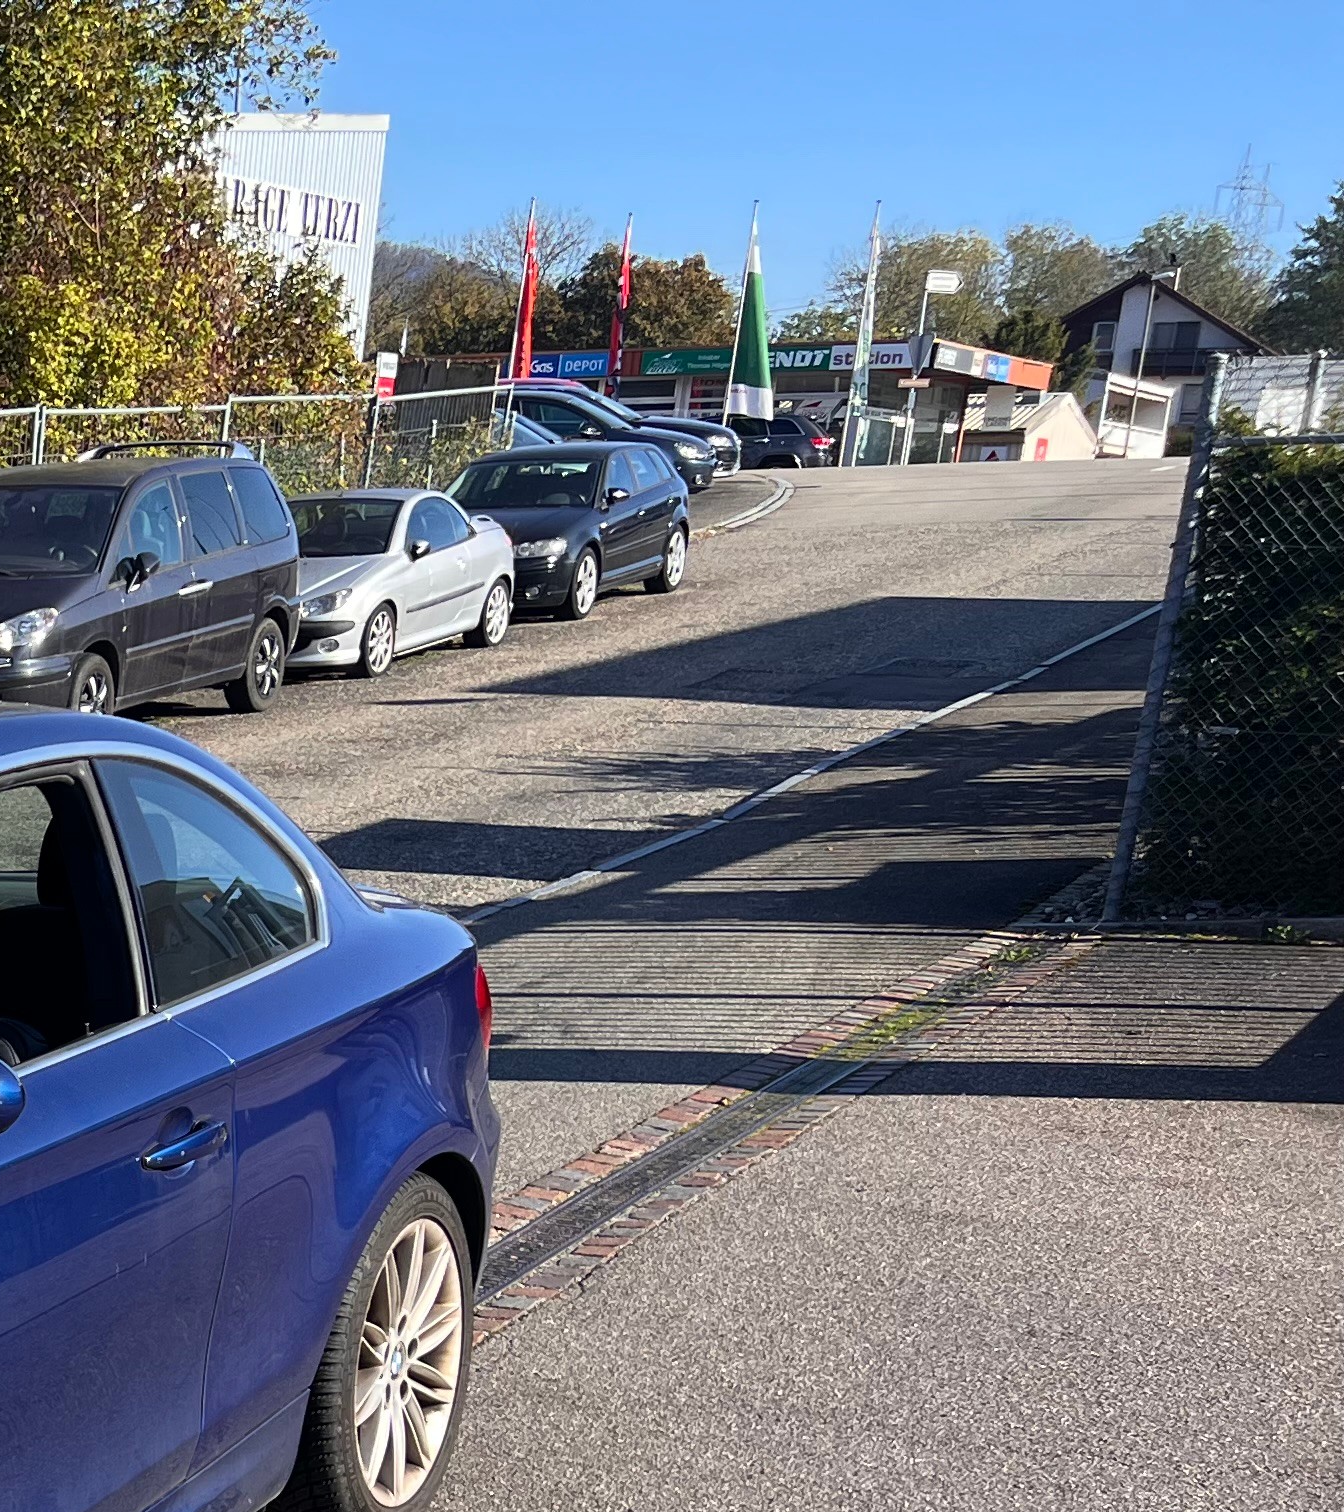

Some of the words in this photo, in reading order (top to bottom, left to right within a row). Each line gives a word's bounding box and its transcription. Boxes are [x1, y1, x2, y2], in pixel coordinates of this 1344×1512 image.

[223, 177, 291, 233] RAGE
[299, 191, 361, 245] TERZI
[768, 349, 830, 368] ENDT
[833, 351, 904, 366] sttion
